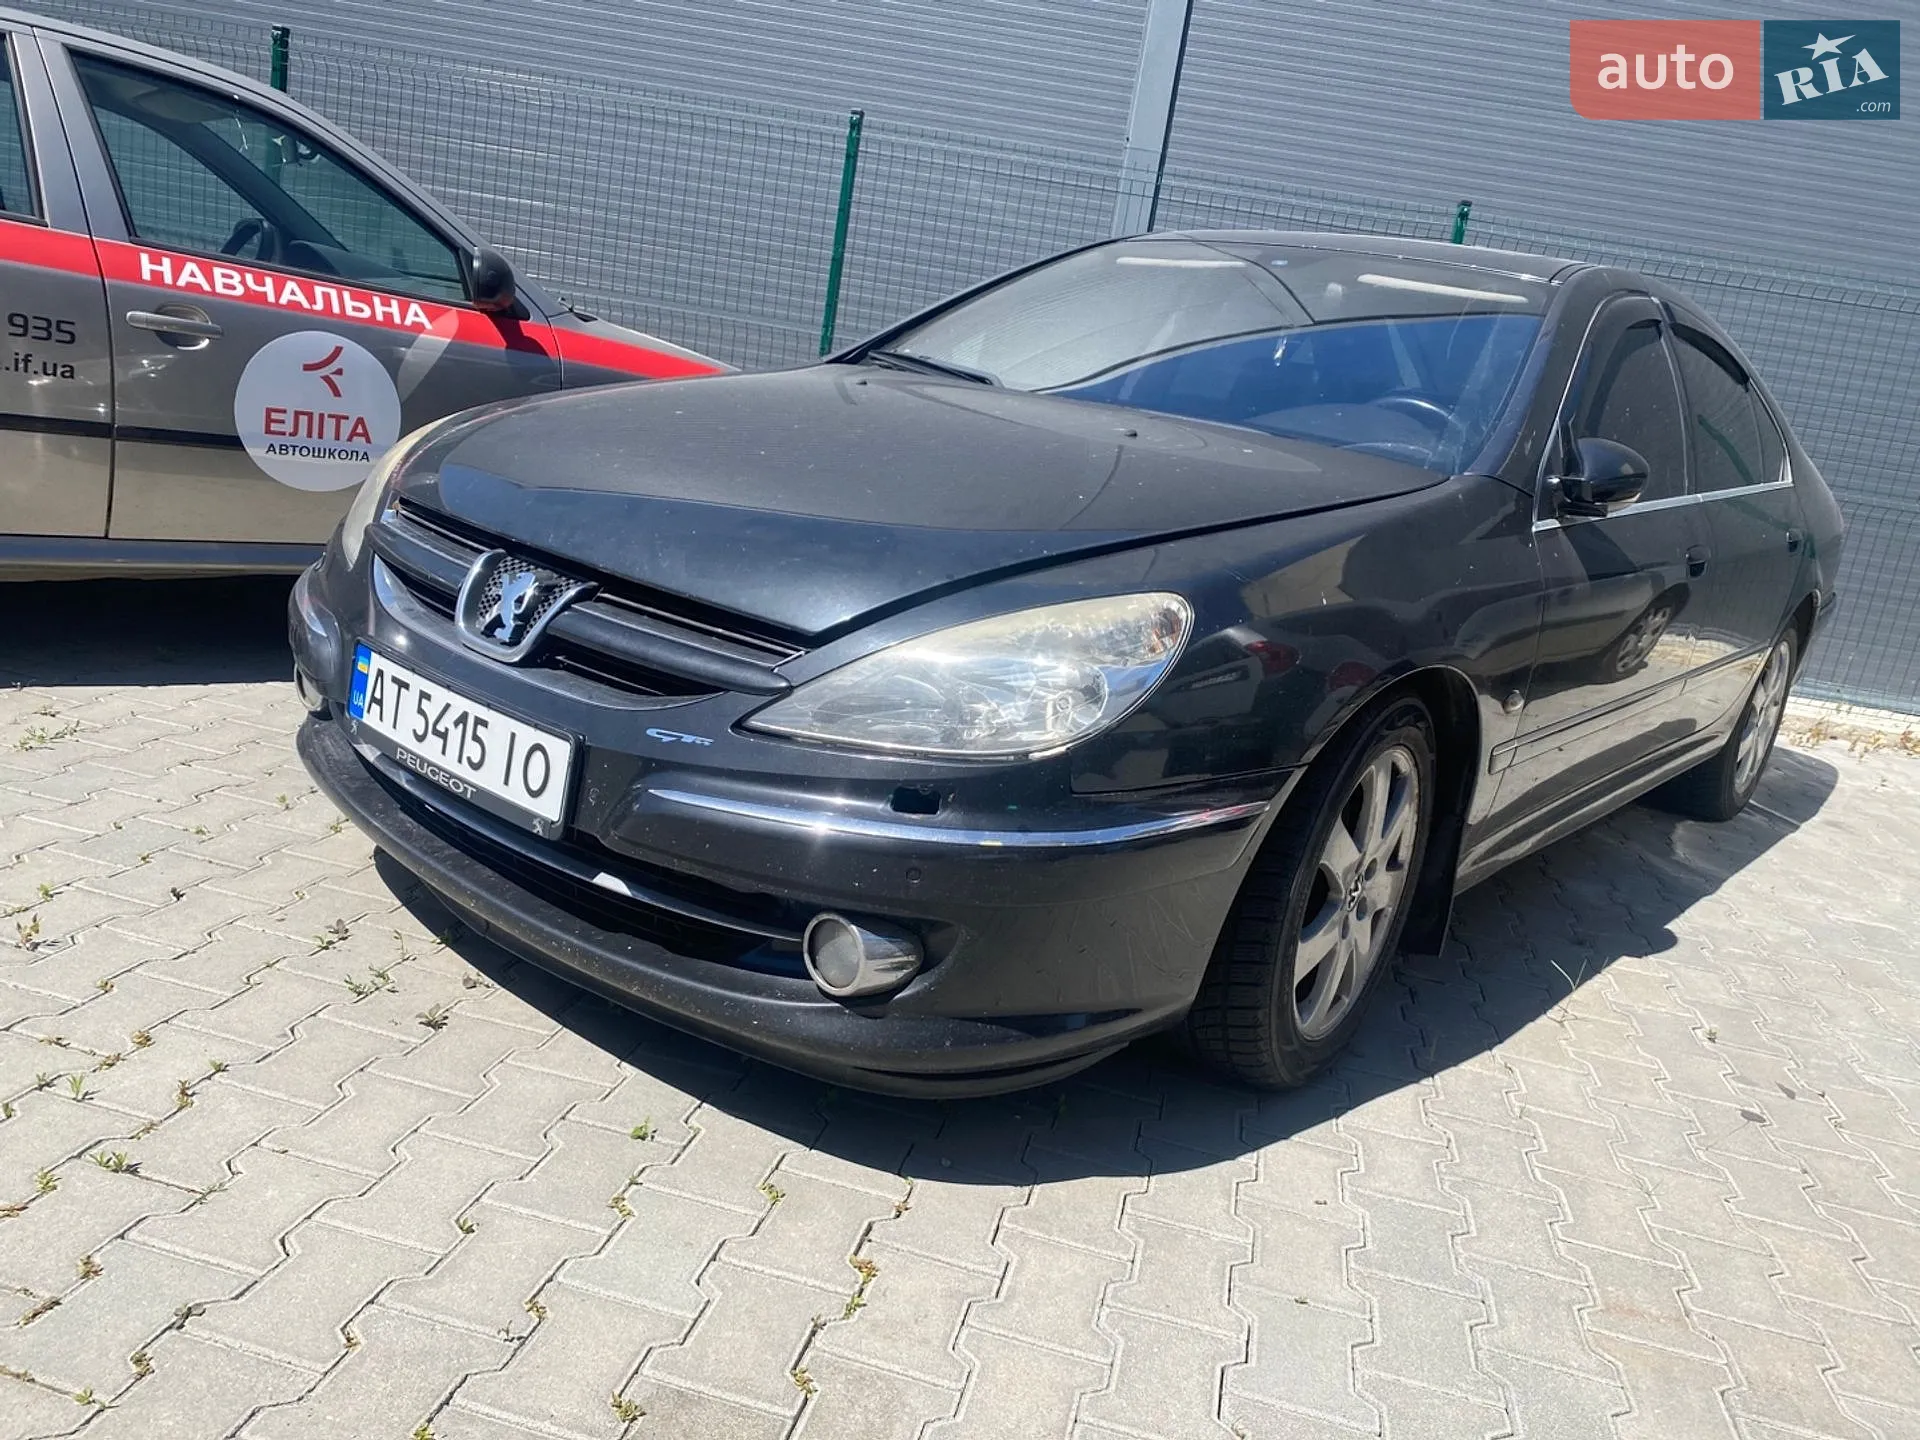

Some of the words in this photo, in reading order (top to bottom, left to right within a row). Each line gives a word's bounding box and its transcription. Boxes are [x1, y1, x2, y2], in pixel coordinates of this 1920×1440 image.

[138, 252, 434, 330] НАВЧАЛЬНА
[7, 312, 76, 344] 935
[0, 352, 75, 379] .if.ua
[264, 406, 373, 445] ЕЛІТА
[265, 442, 371, 463] АВТОШКОЛА
[353, 690, 364, 709] UA
[366, 668, 410, 730] AT
[412, 693, 489, 771] 5415
[503, 732, 551, 798] IO
[395, 747, 476, 800] PEUGEOT
